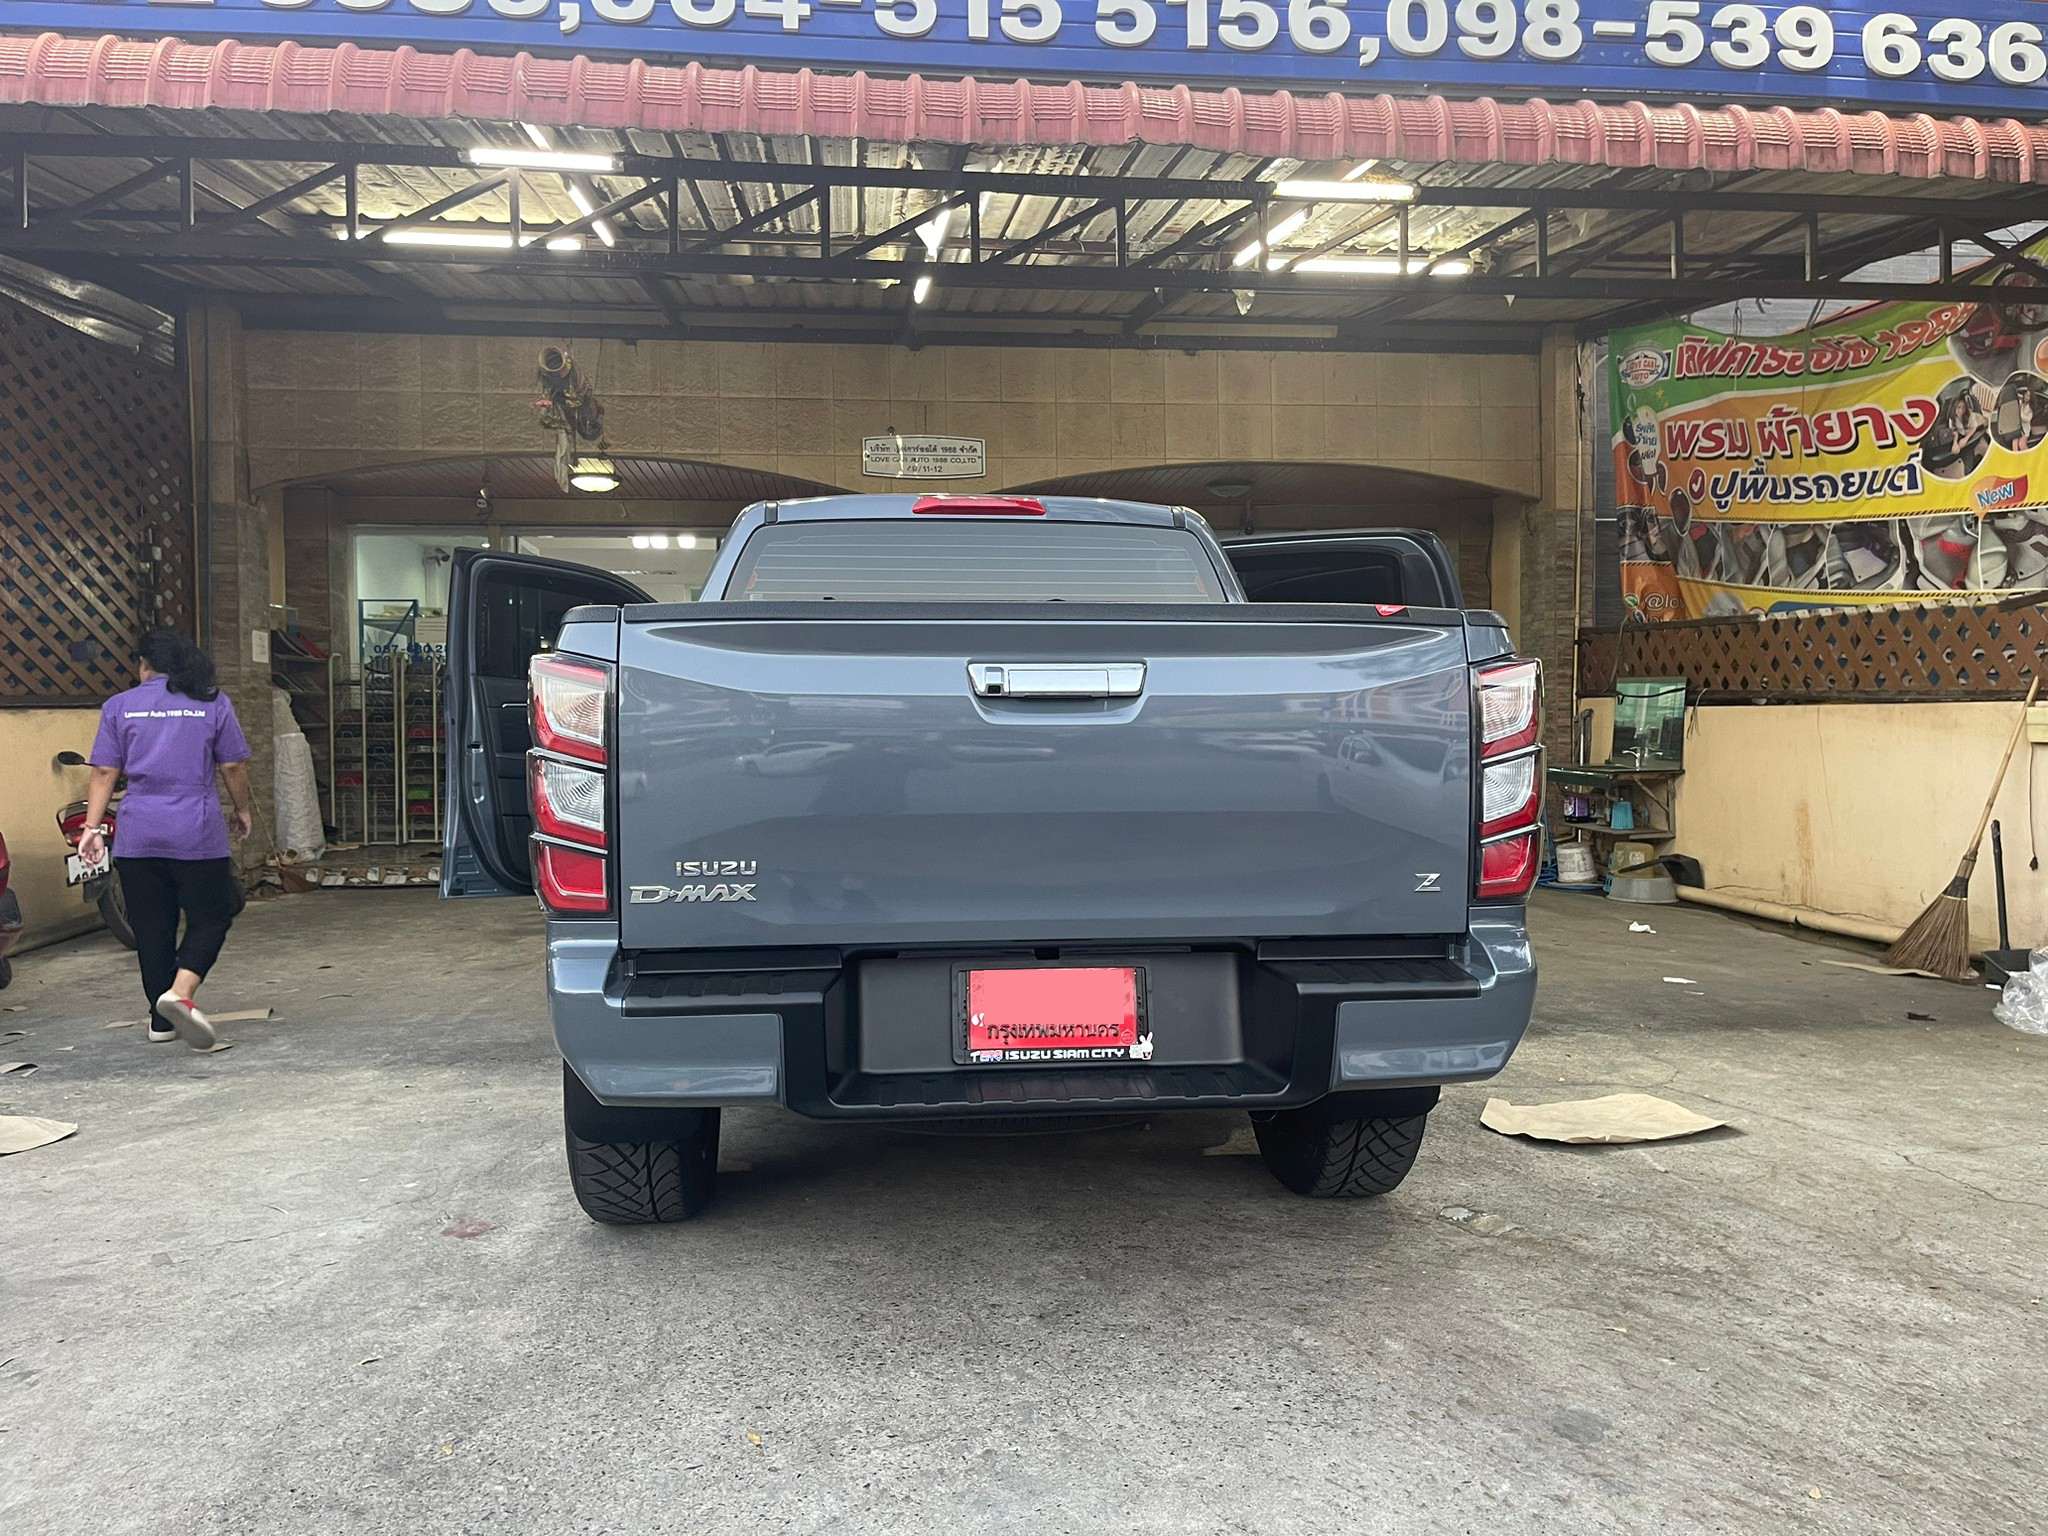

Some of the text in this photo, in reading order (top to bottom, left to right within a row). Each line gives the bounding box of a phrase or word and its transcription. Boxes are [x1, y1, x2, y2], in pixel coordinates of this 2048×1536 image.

[1862, 13, 2048, 85] 636
[1976, 481, 2014, 509] New
[675, 860, 757, 877] ISUZU
[1414, 873, 1442, 892] Z
[629, 883, 757, 904] D-MAX
[987, 1023, 1119, 1045] กรุงเทพมหานคร
[1005, 1050, 1051, 1060] ISUZU
[1052, 1049, 1090, 1060] SIAM
[1091, 1048, 1125, 1058] CITY
